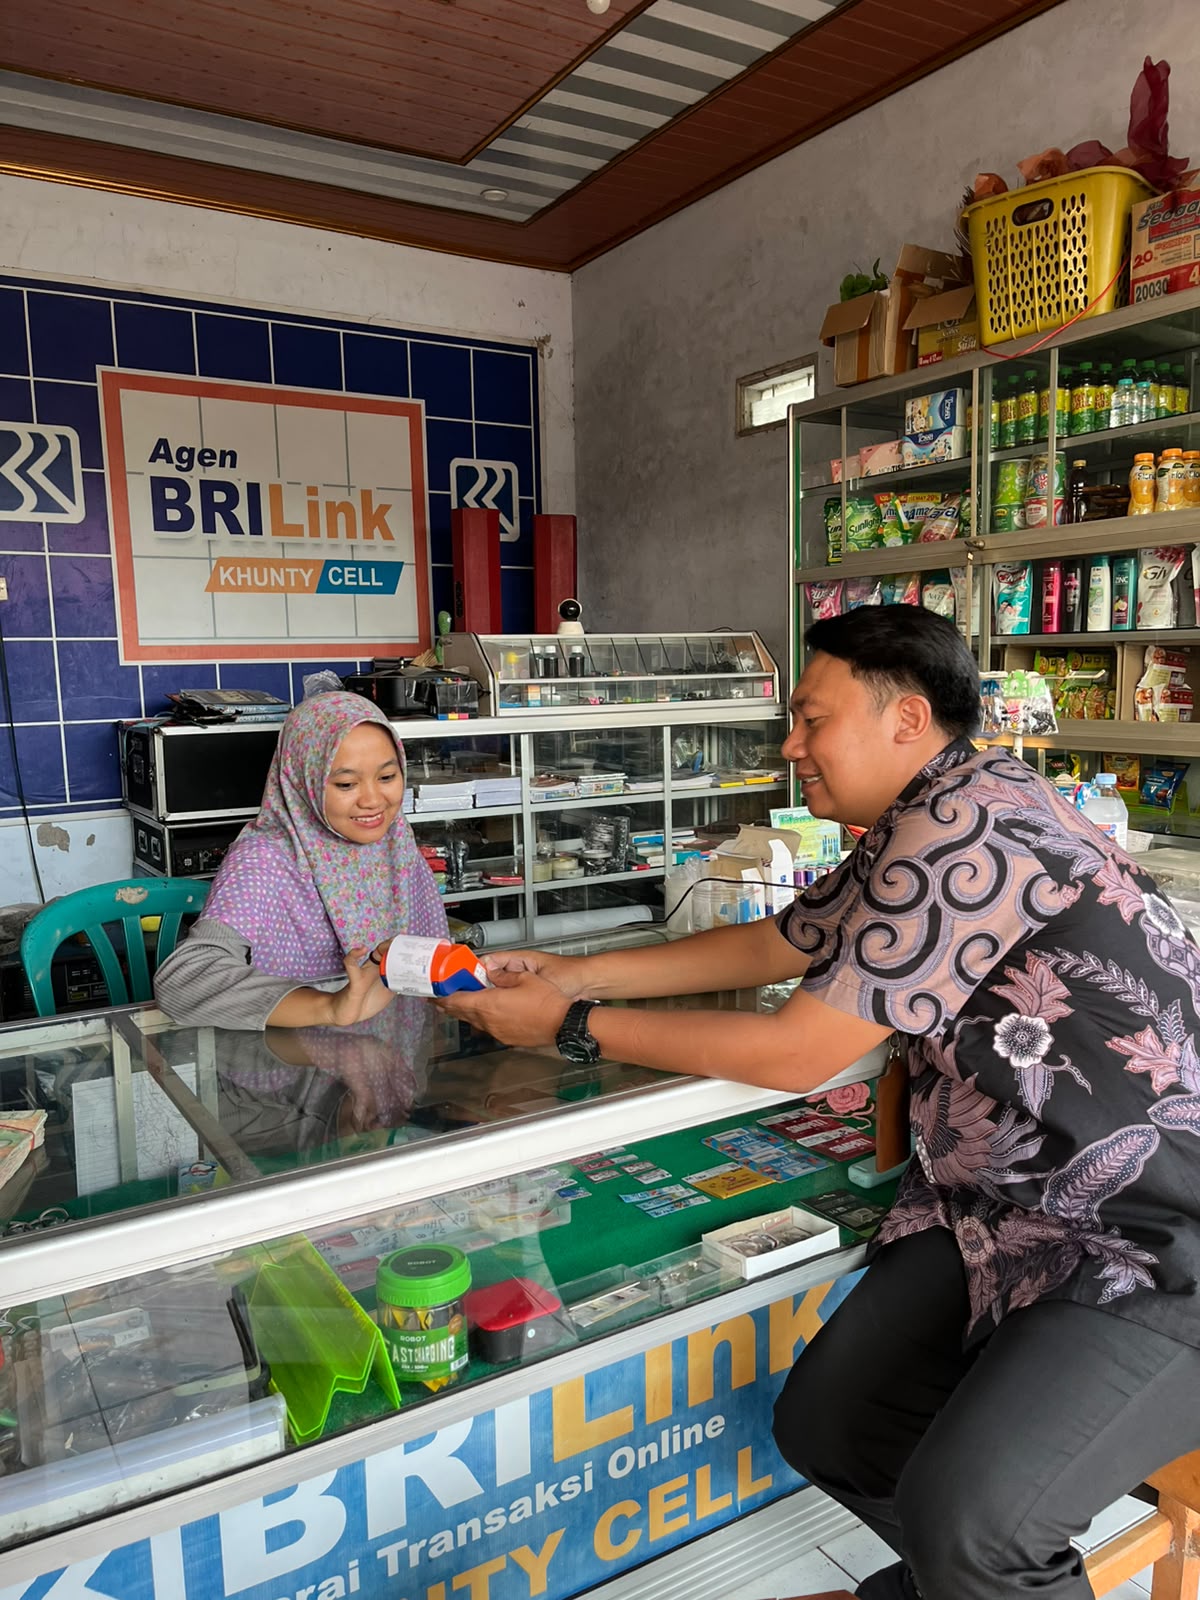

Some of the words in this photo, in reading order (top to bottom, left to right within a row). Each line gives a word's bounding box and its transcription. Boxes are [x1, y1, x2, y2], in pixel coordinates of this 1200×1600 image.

[1132, 250, 1153, 270] 20
[1135, 277, 1169, 303] 20030
[148, 437, 238, 471] Agen
[150, 475, 395, 541] BRILink
[219, 565, 314, 588] KHUNTY
[327, 566, 384, 587] CELL
[400, 1335, 427, 1343] ROBOT
[376, 1461, 594, 1577] Transaksi
[607, 1413, 726, 1480] Online
[593, 1447, 773, 1562] CELL
